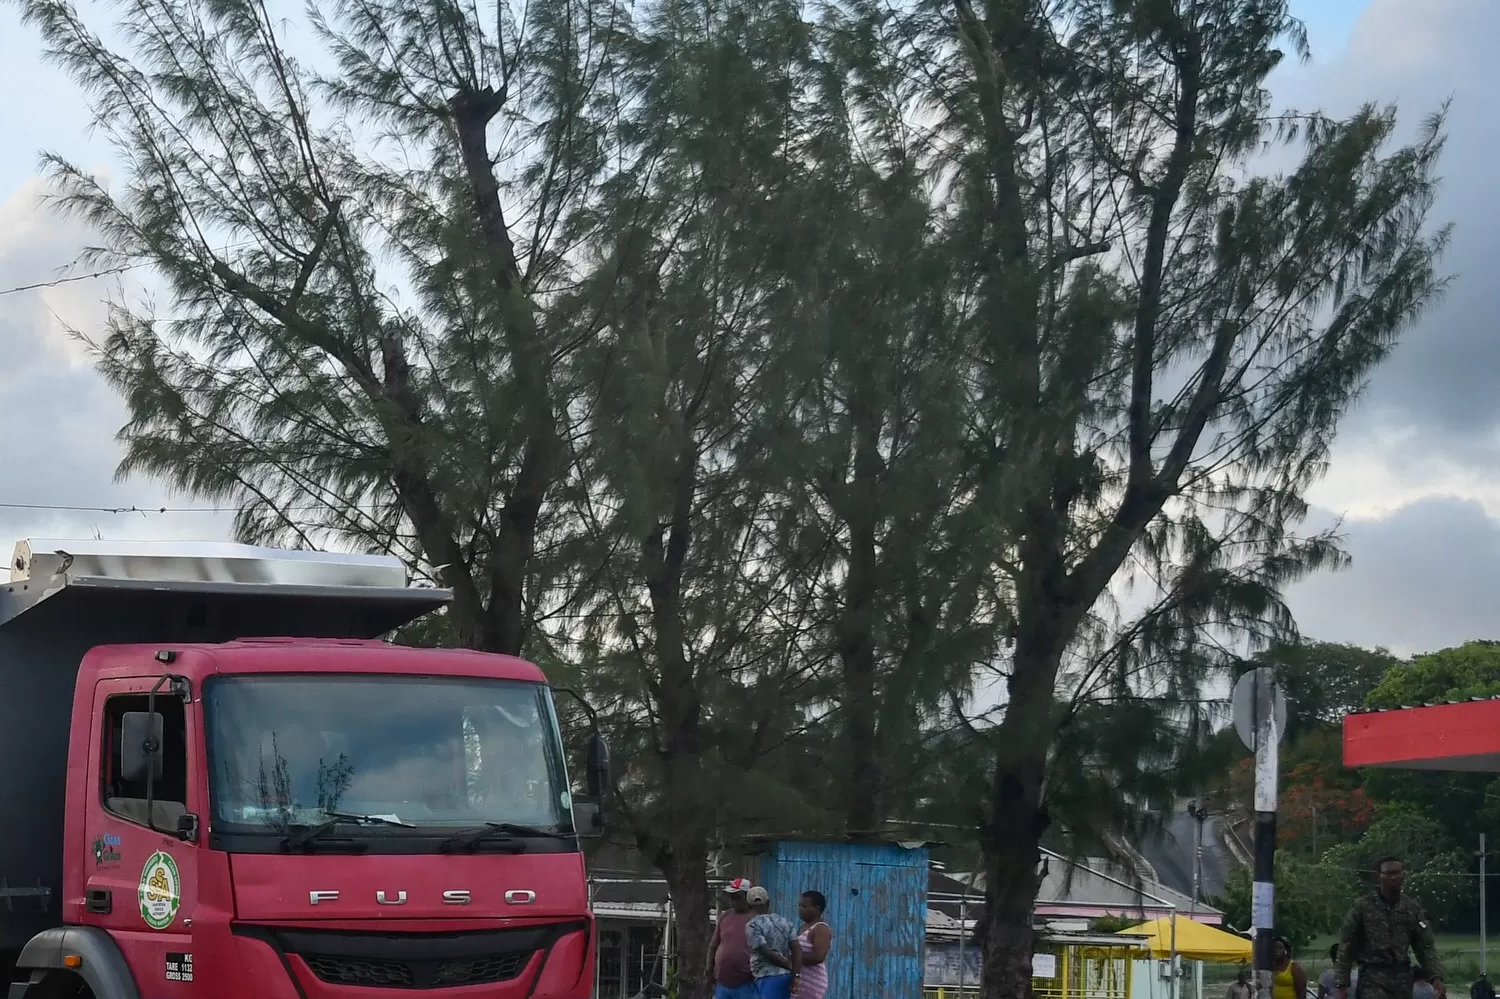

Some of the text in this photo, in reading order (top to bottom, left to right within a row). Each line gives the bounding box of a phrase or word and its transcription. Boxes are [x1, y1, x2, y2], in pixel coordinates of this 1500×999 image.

[310, 889, 536, 905] FUSO
[166, 961, 178, 971] TARE
[166, 971, 180, 980] GROSS
